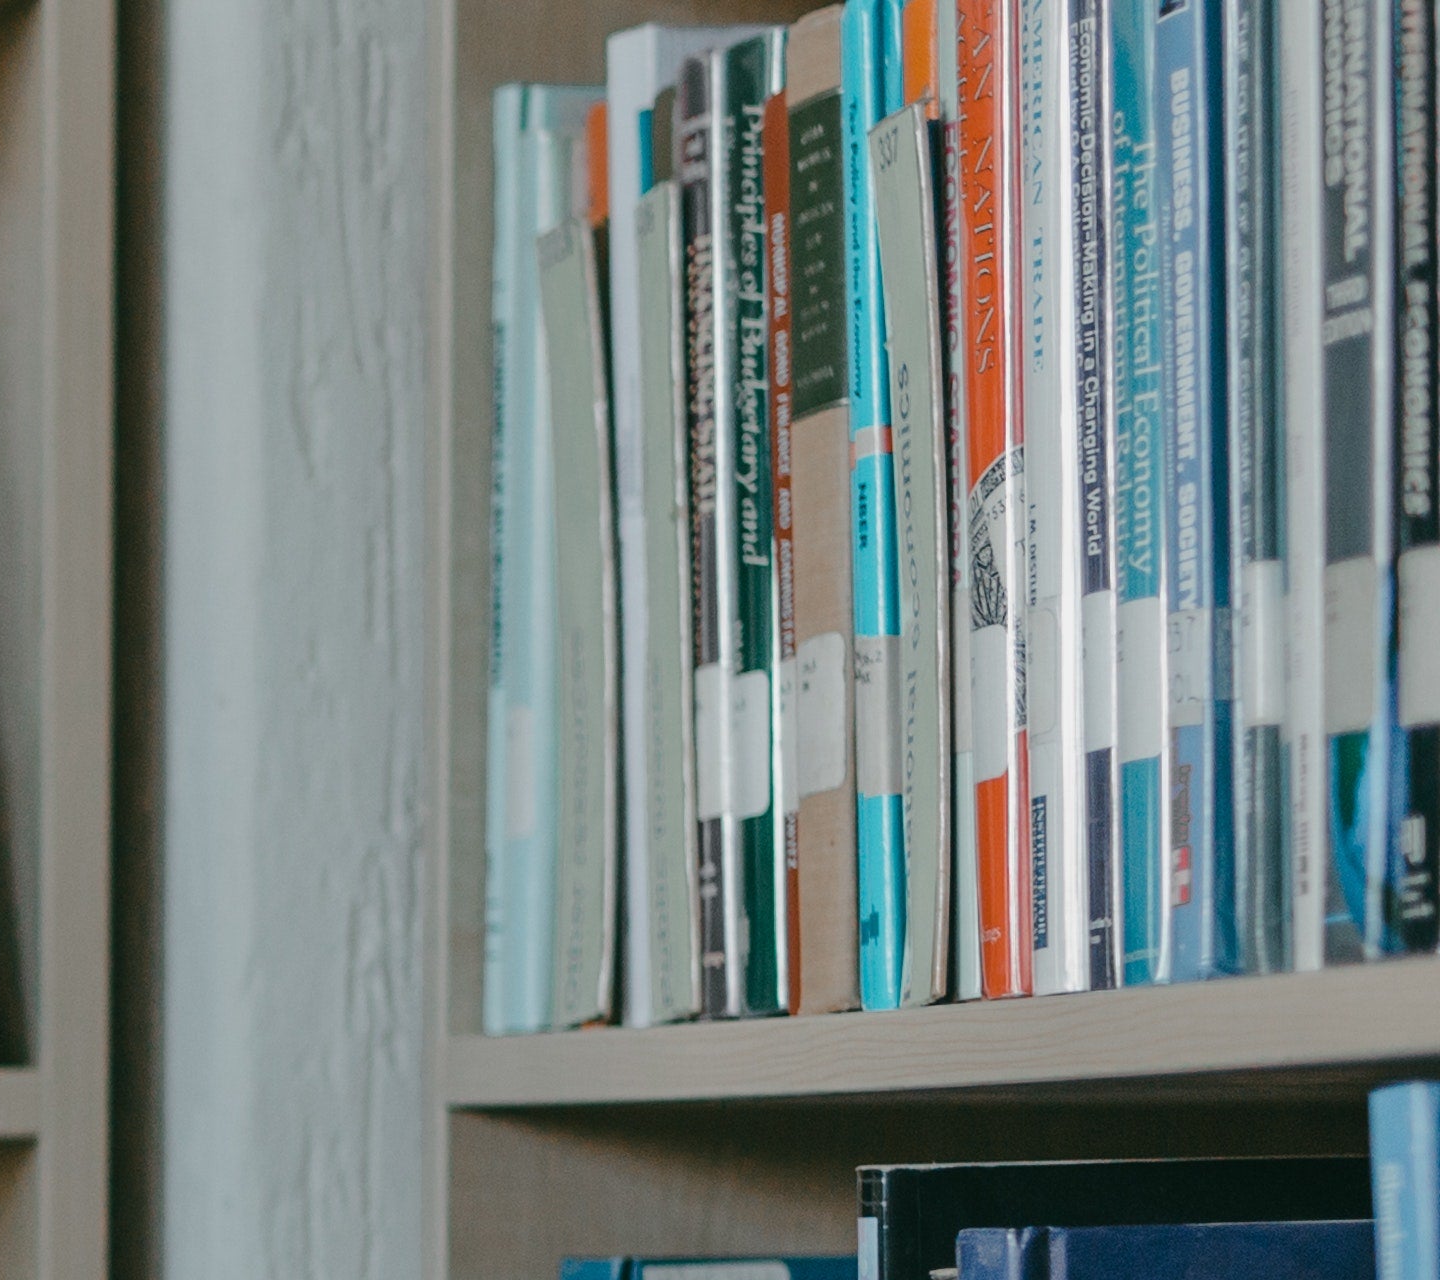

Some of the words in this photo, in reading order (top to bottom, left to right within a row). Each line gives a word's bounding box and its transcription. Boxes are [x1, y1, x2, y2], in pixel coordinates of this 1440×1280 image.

[1079, 15, 1095, 128] Economic
[734, 103, 768, 267] Principles
[1112, 112, 1130, 151] of
[1131, 131, 1156, 209] The
[771, 213, 787, 321] MUNICIPAL
[852, 257, 860, 293] the
[972, 134, 995, 375] NATIONS
[1079, 132, 1097, 325] Decision-Making
[738, 271, 769, 307] of
[1031, 226, 1043, 373] TRADE
[1083, 329, 1097, 354] in
[1112, 162, 1132, 417] International
[1132, 220, 1161, 379] Political
[734, 317, 769, 494] Budgetary
[1084, 357, 1094, 371] a
[1403, 280, 1430, 516] ECONOMICS
[1081, 375, 1100, 484] Changing
[1133, 387, 1160, 574] Economy
[741, 498, 769, 567] and
[858, 482, 868, 551] NBER
[897, 362, 921, 651] economics
[1086, 488, 1101, 556] World
[1178, 482, 1197, 610] SOCIETY
[1029, 543, 1037, 607] DESTLER
